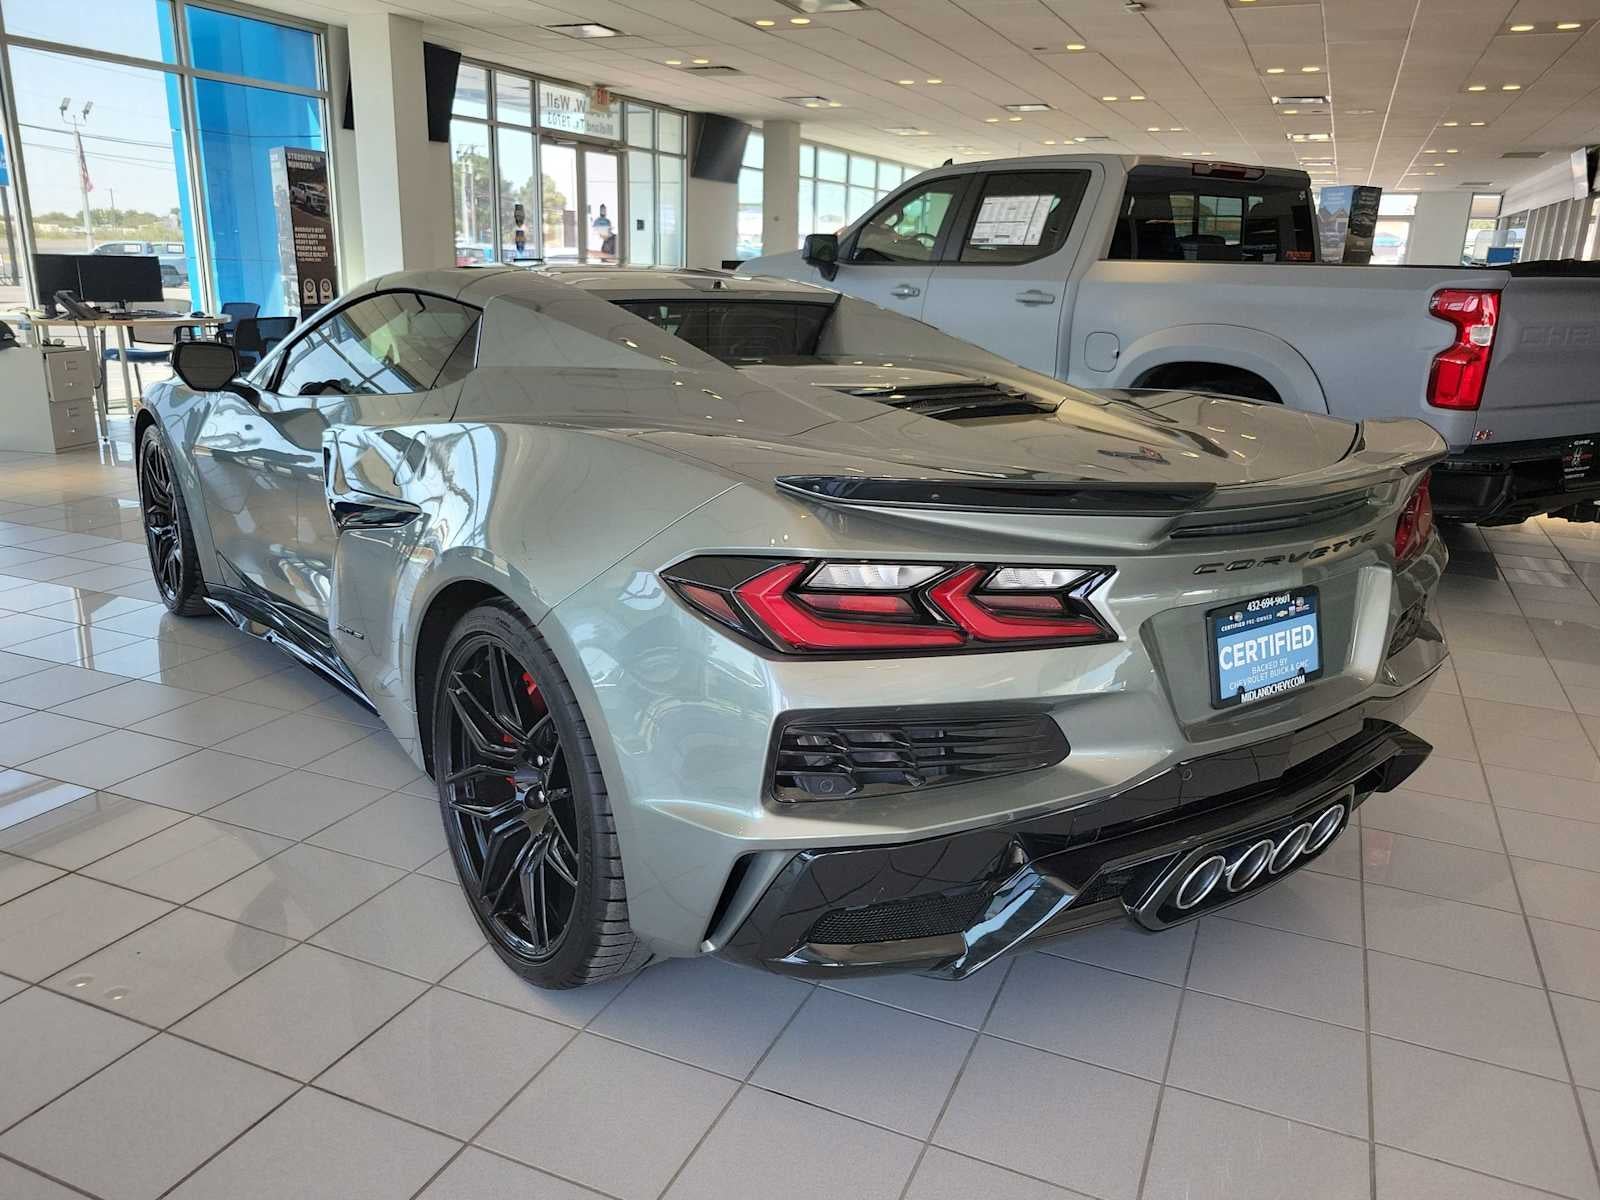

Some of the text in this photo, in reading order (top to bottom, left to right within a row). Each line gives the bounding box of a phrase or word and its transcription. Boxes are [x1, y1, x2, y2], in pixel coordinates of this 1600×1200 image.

[1192, 530, 1377, 575] CORVETTE
[1221, 621, 1245, 632] CERTIFIED
[1219, 624, 1315, 670] CERTIFIED
[1229, 672, 1268, 691] CHEVROLET
[1270, 665, 1290, 676] BUICK
[1251, 657, 1288, 675] BACKED BY
[1241, 675, 1306, 703] MIDLANDCHEVY.COM
